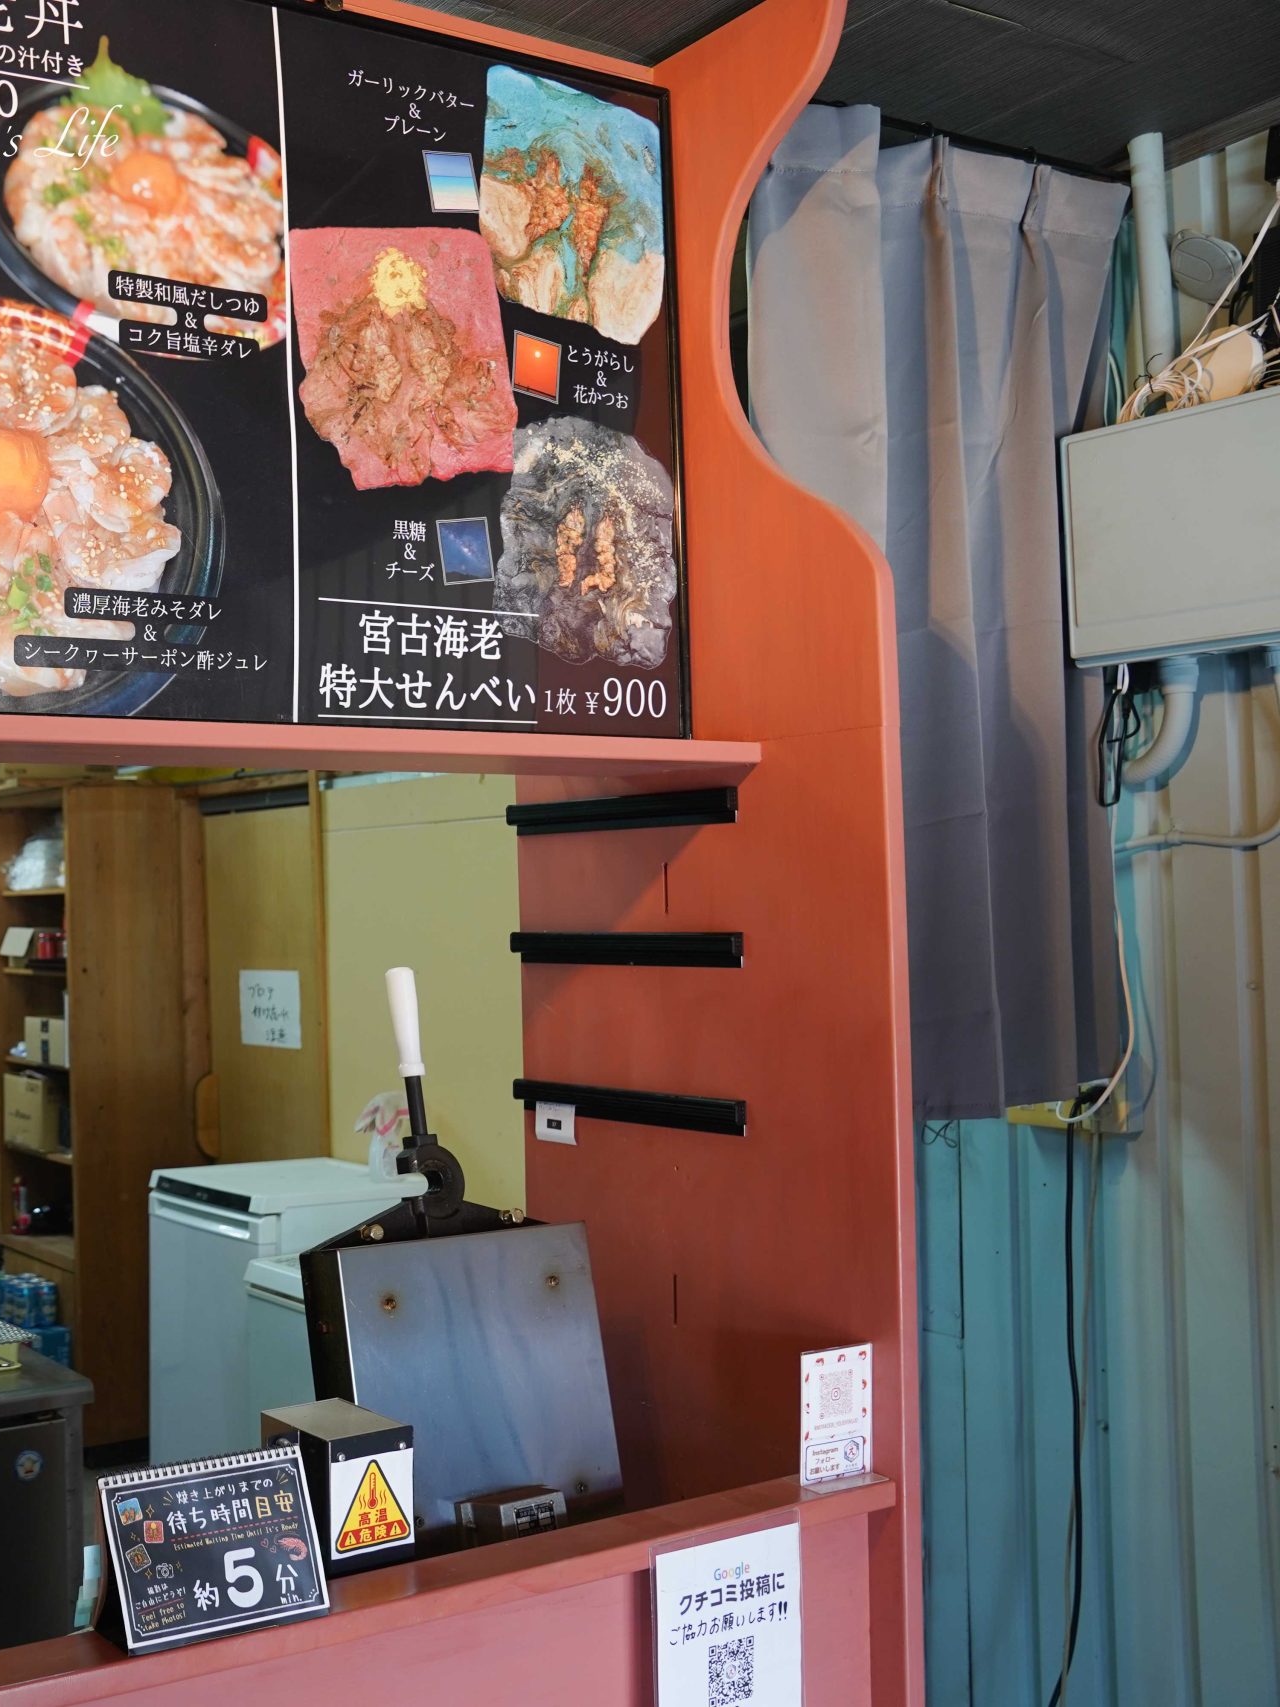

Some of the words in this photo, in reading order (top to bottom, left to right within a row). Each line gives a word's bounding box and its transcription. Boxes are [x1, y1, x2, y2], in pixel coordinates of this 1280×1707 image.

[348, 69, 475, 109] ガーリックバター
[408, 102, 422, 119] &
[384, 115, 447, 143] プレーン
[115, 275, 260, 315] 特製和風だしつゆ
[184, 312, 198, 329] &
[128, 327, 253, 359] コク旨塩辛ダレ
[567, 345, 635, 374] とうがらし
[596, 372, 608, 388] &
[573, 384, 630, 410] 花かつお
[392, 519, 427, 543] 黒糖
[403, 542, 417, 561] &
[385, 560, 436, 582] チーズ
[72, 593, 223, 621] 濃厚海老みそダレ
[143, 624, 158, 643] &
[358, 609, 504, 660] 宮古海老
[319, 662, 536, 712] 特大せんべい
[543, 687, 577, 716] 1枚
[585, 677, 667, 718] ¥900
[176, 1478, 273, 1504] 焼き上がりまでの
[166, 1489, 294, 1535] 待ち時間目安
[358, 1508, 388, 1526] 高温
[360, 1525, 387, 1542] 危険
[714, 1562, 750, 1580] Google
[280, 1593, 303, 1604] min.
[679, 1572, 785, 1616] クチコミ投稿に
[141, 1611, 156, 1623] Feel
